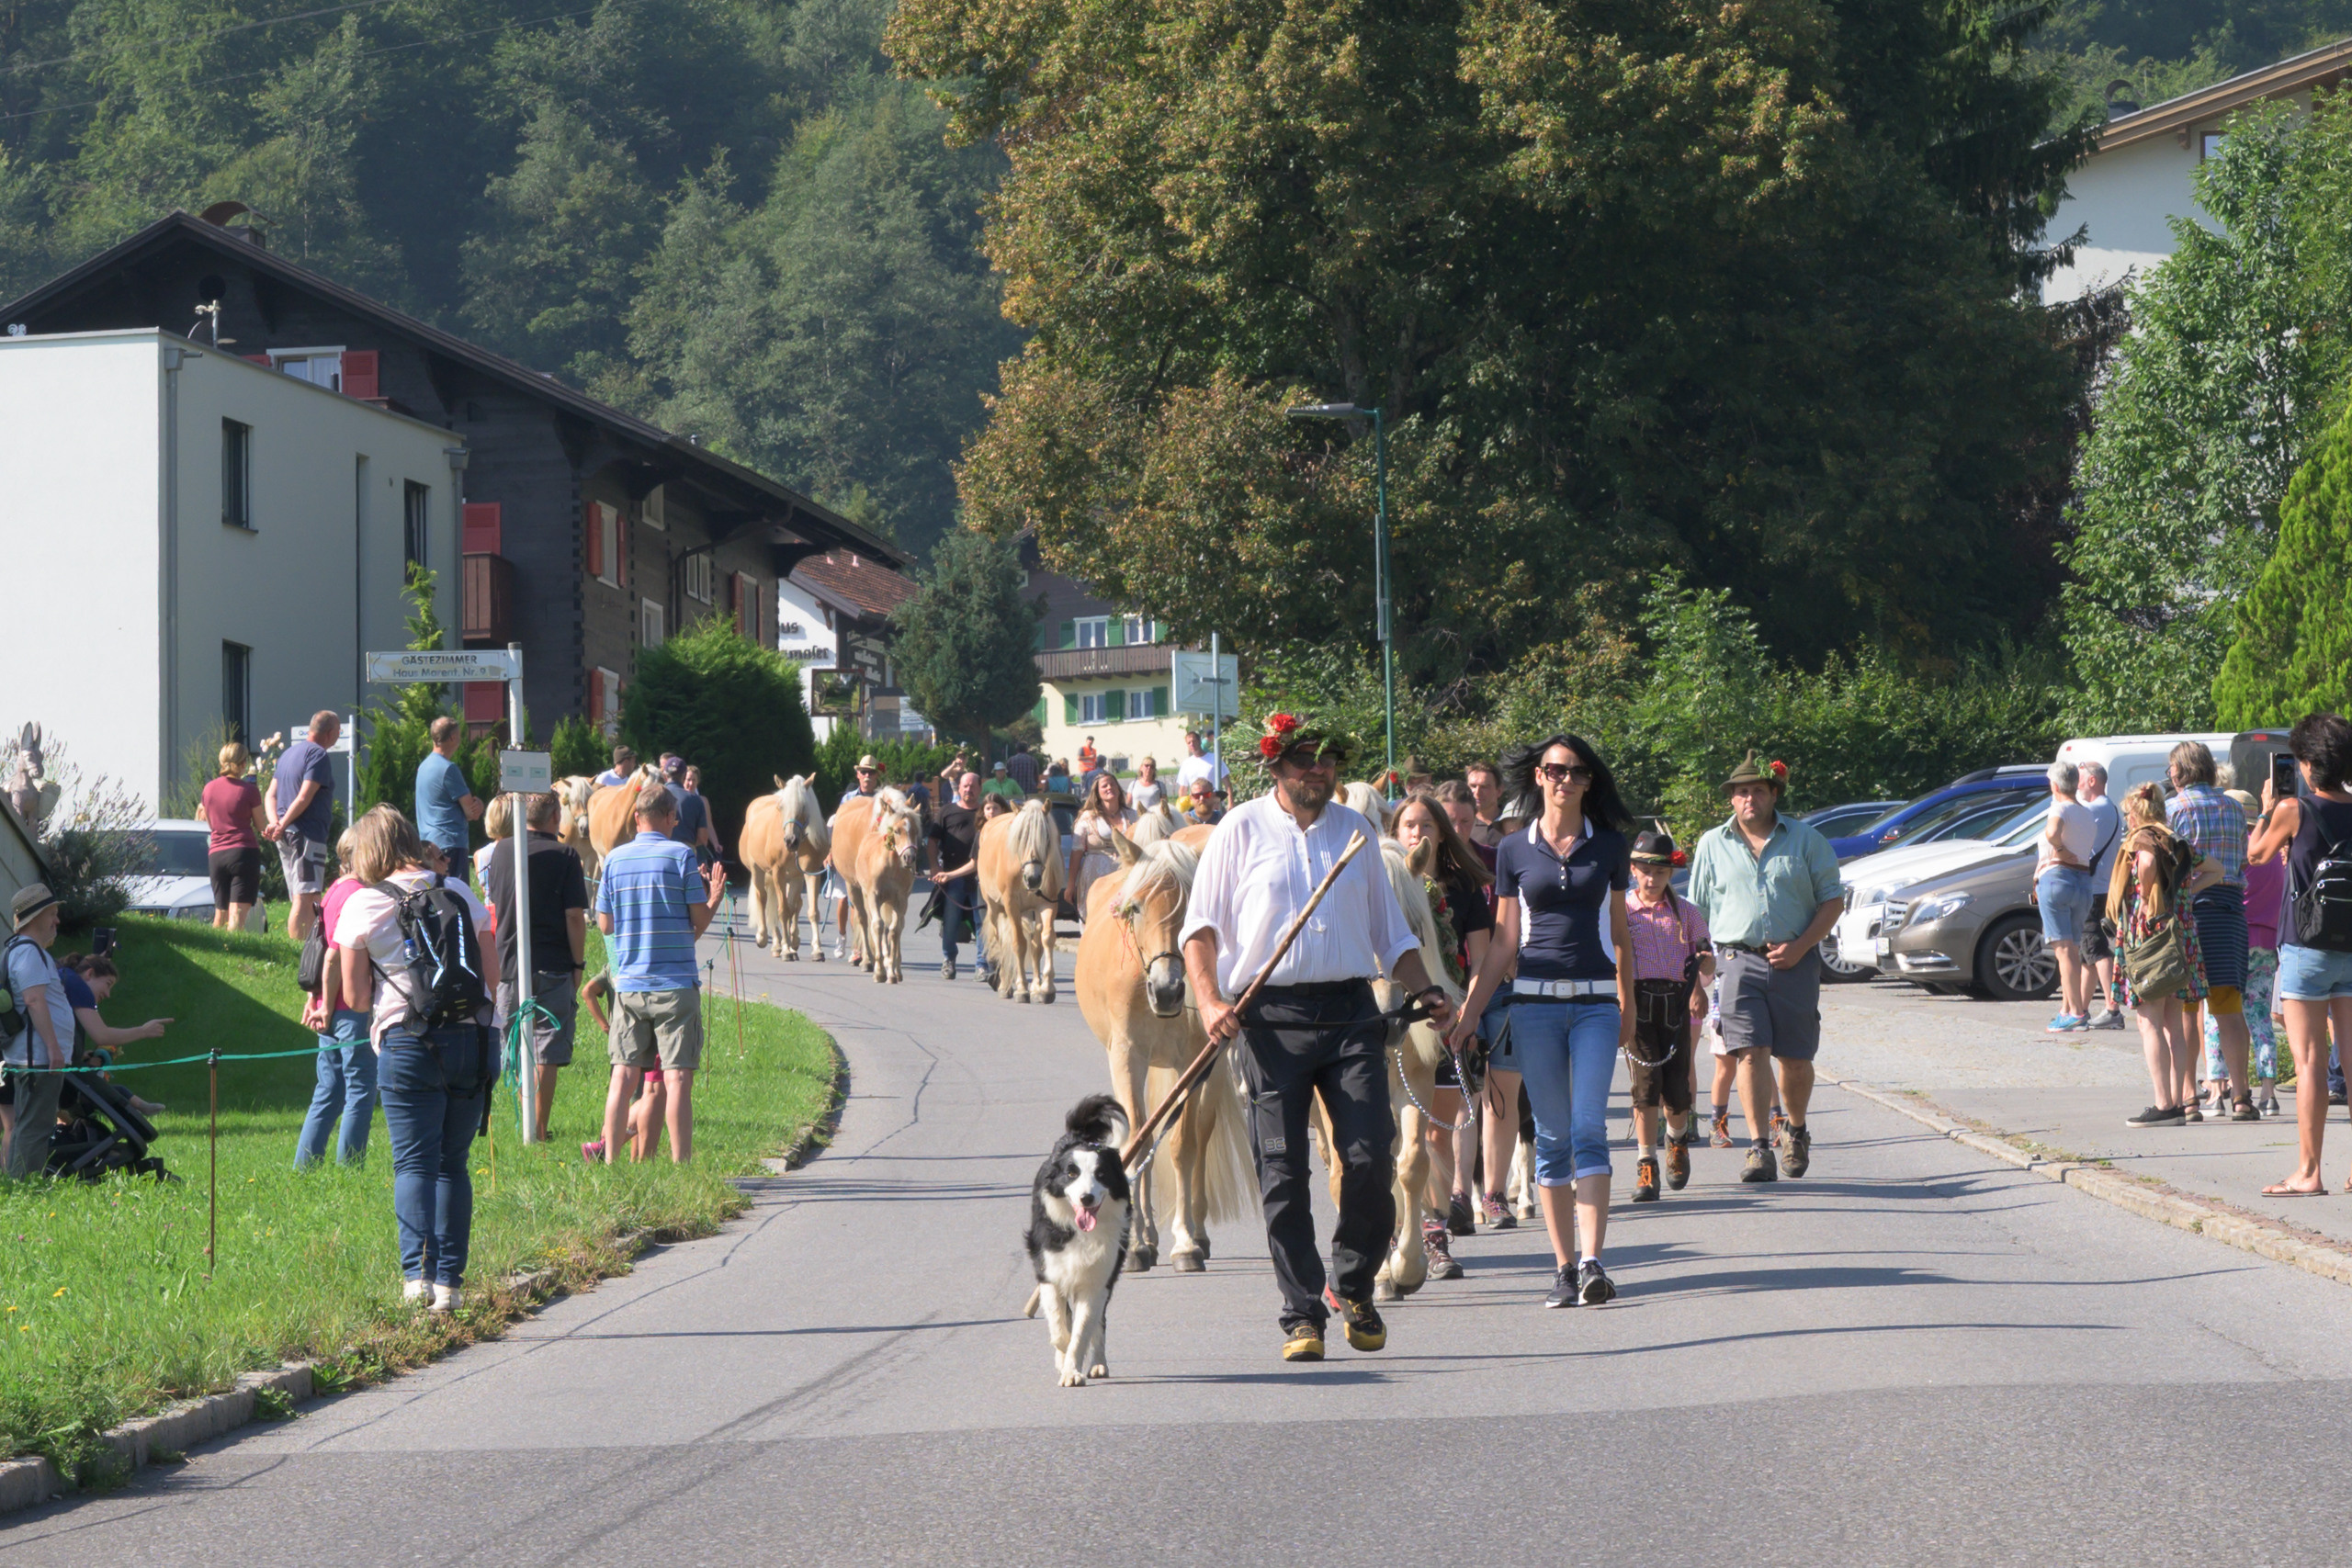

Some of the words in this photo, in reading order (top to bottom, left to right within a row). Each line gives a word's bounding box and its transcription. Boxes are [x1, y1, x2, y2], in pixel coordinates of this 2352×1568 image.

[401, 655, 477, 665] GÄSTEZIMMER
[392, 668, 419, 678] Haus
[462, 667, 478, 677] Nr.
[480, 667, 486, 675] 9
